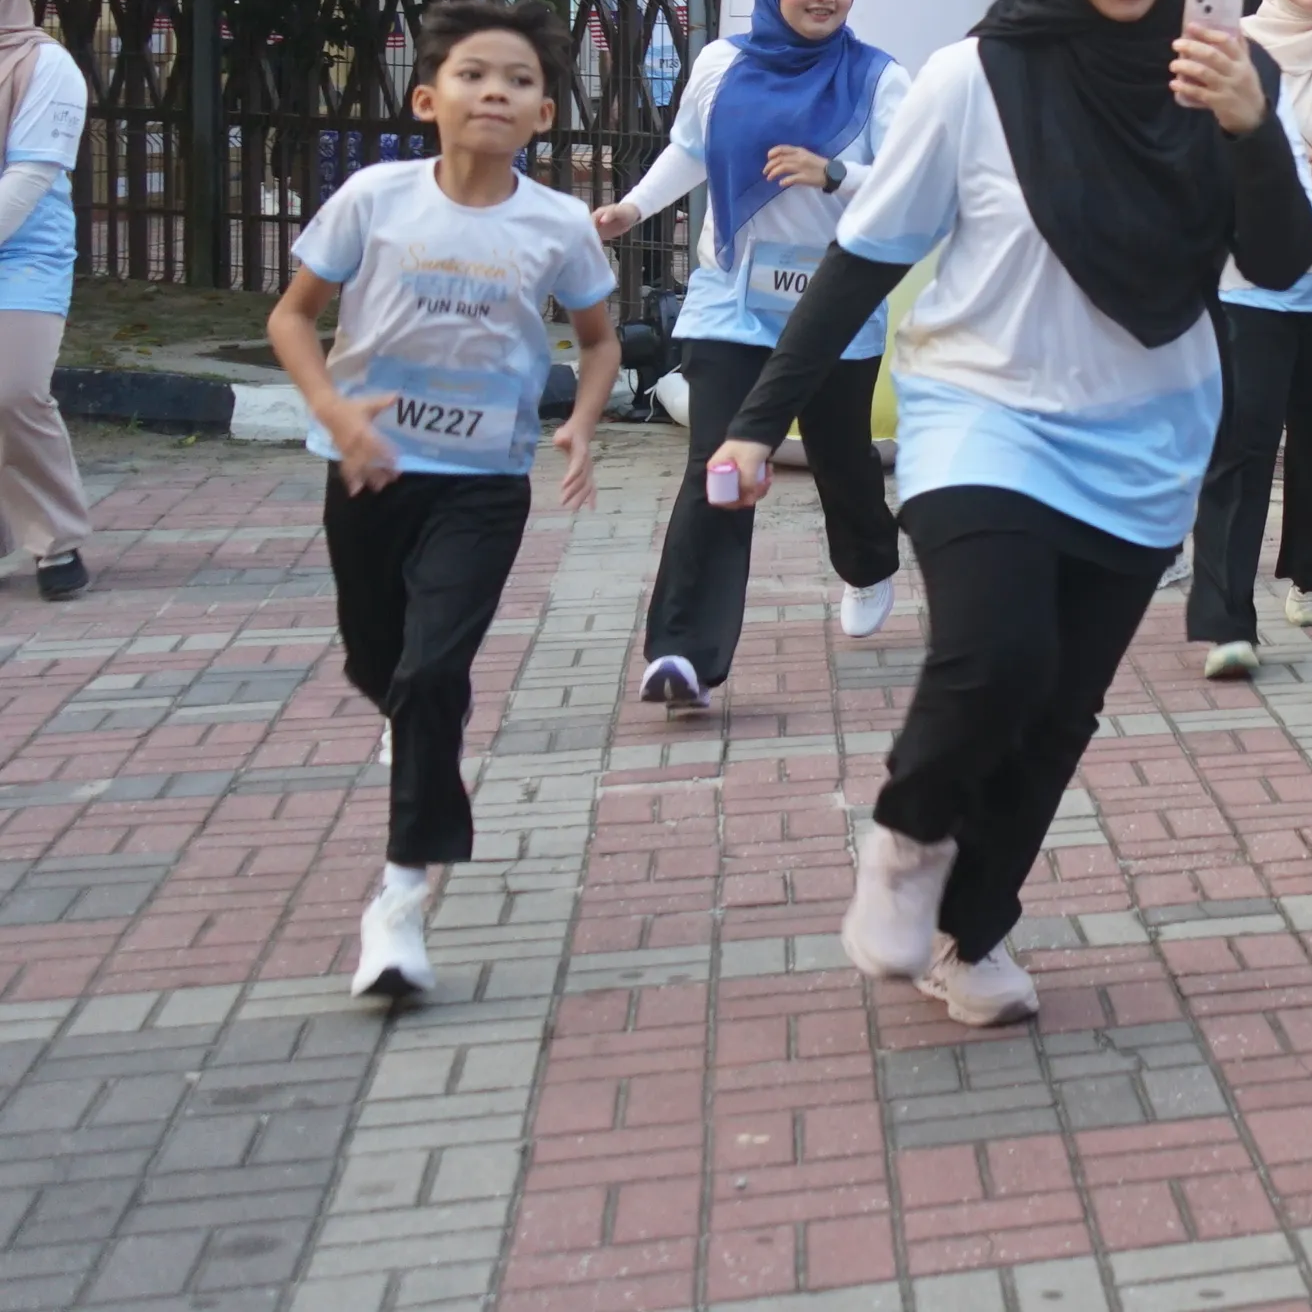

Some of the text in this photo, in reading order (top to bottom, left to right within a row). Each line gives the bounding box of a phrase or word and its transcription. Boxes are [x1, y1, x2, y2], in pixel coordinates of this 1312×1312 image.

[774, 270, 808, 293] W0
[417, 296, 490, 318] FUN RUN
[396, 396, 484, 438] W227
